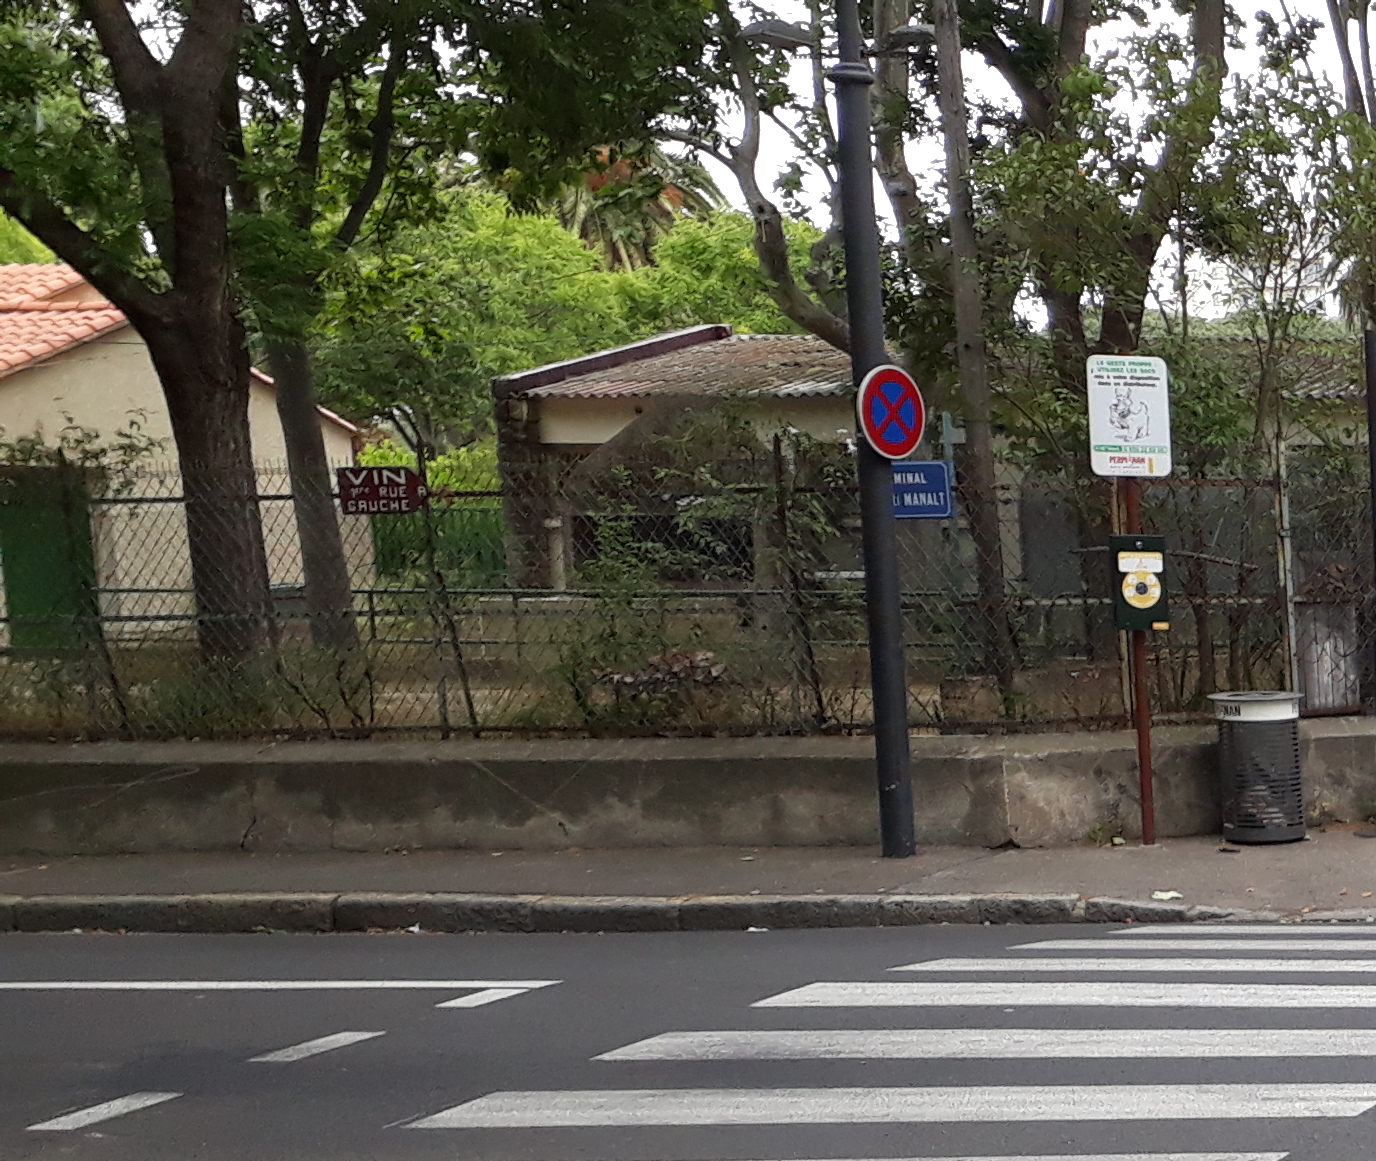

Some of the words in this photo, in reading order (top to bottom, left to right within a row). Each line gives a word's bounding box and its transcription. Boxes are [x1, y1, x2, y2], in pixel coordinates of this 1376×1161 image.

[345, 469, 407, 485] VIN
[893, 471, 928, 485] MINAL
[379, 484, 408, 498] RUE
[903, 491, 945, 506] MANALT
[346, 499, 411, 513] GAUCHE
